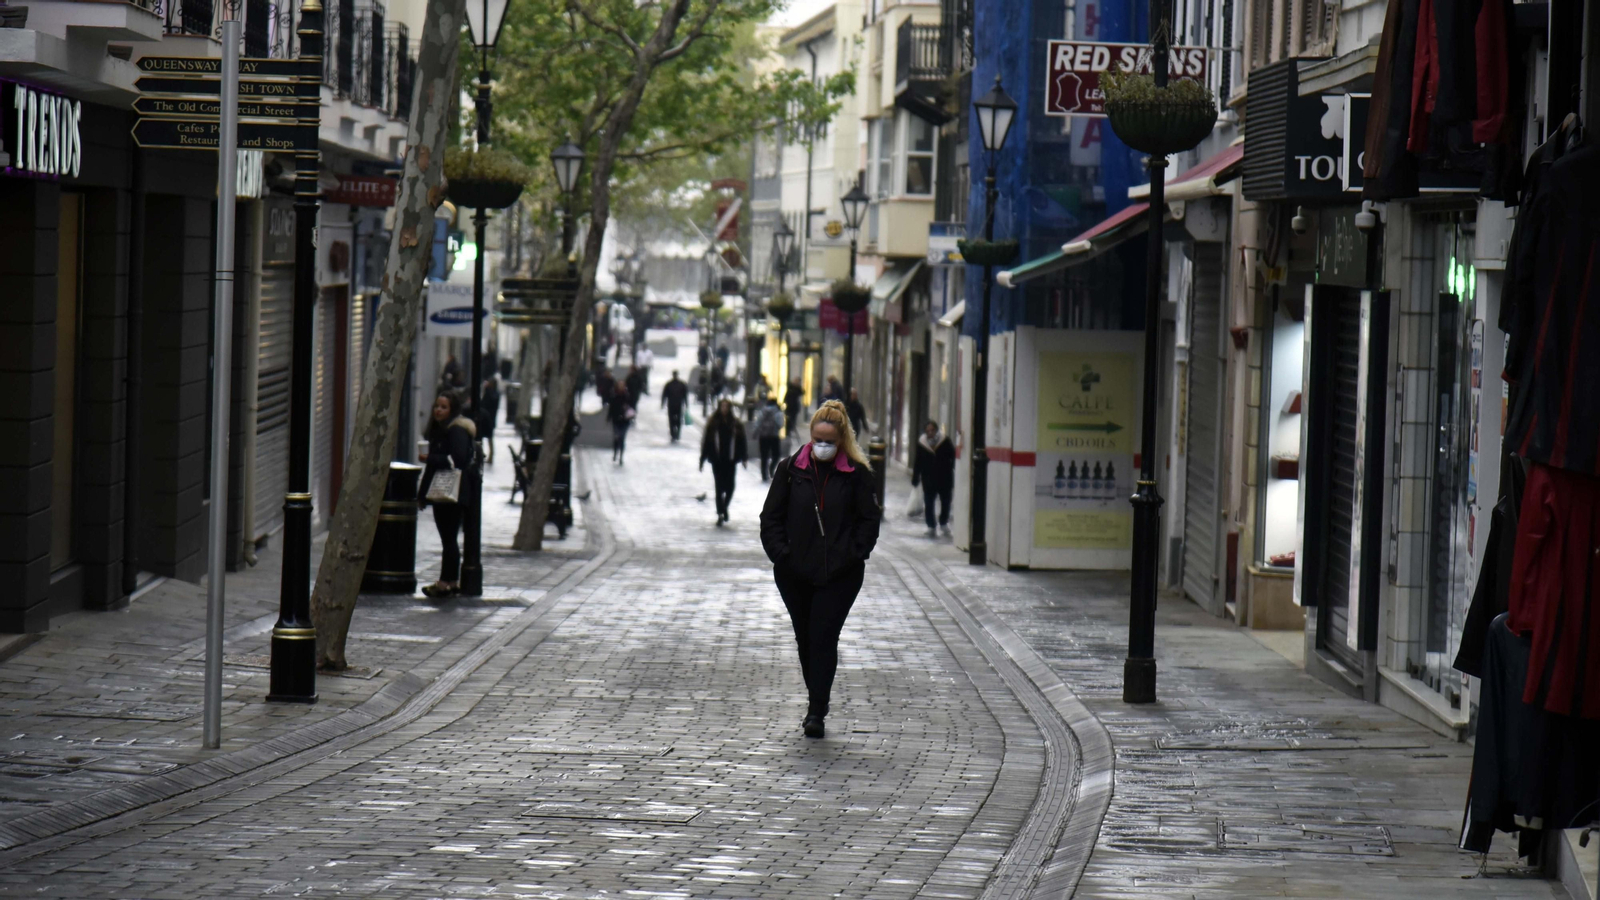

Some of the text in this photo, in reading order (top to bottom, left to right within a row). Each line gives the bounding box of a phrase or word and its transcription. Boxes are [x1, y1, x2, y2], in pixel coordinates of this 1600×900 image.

[144, 59, 259, 72] QUEENSWAY AY
[1054, 45, 1204, 76] RED SKNS
[259, 84, 296, 95] TOWN
[1084, 88, 1106, 100] LEA
[154, 101, 295, 116] The Old Comrcial Street
[14, 83, 82, 178] TRENDS
[177, 123, 205, 133] Cafes
[180, 134, 295, 149] Restaur and Shops
[342, 180, 380, 194] ELITE
[437, 310, 474, 320] SAMSU
